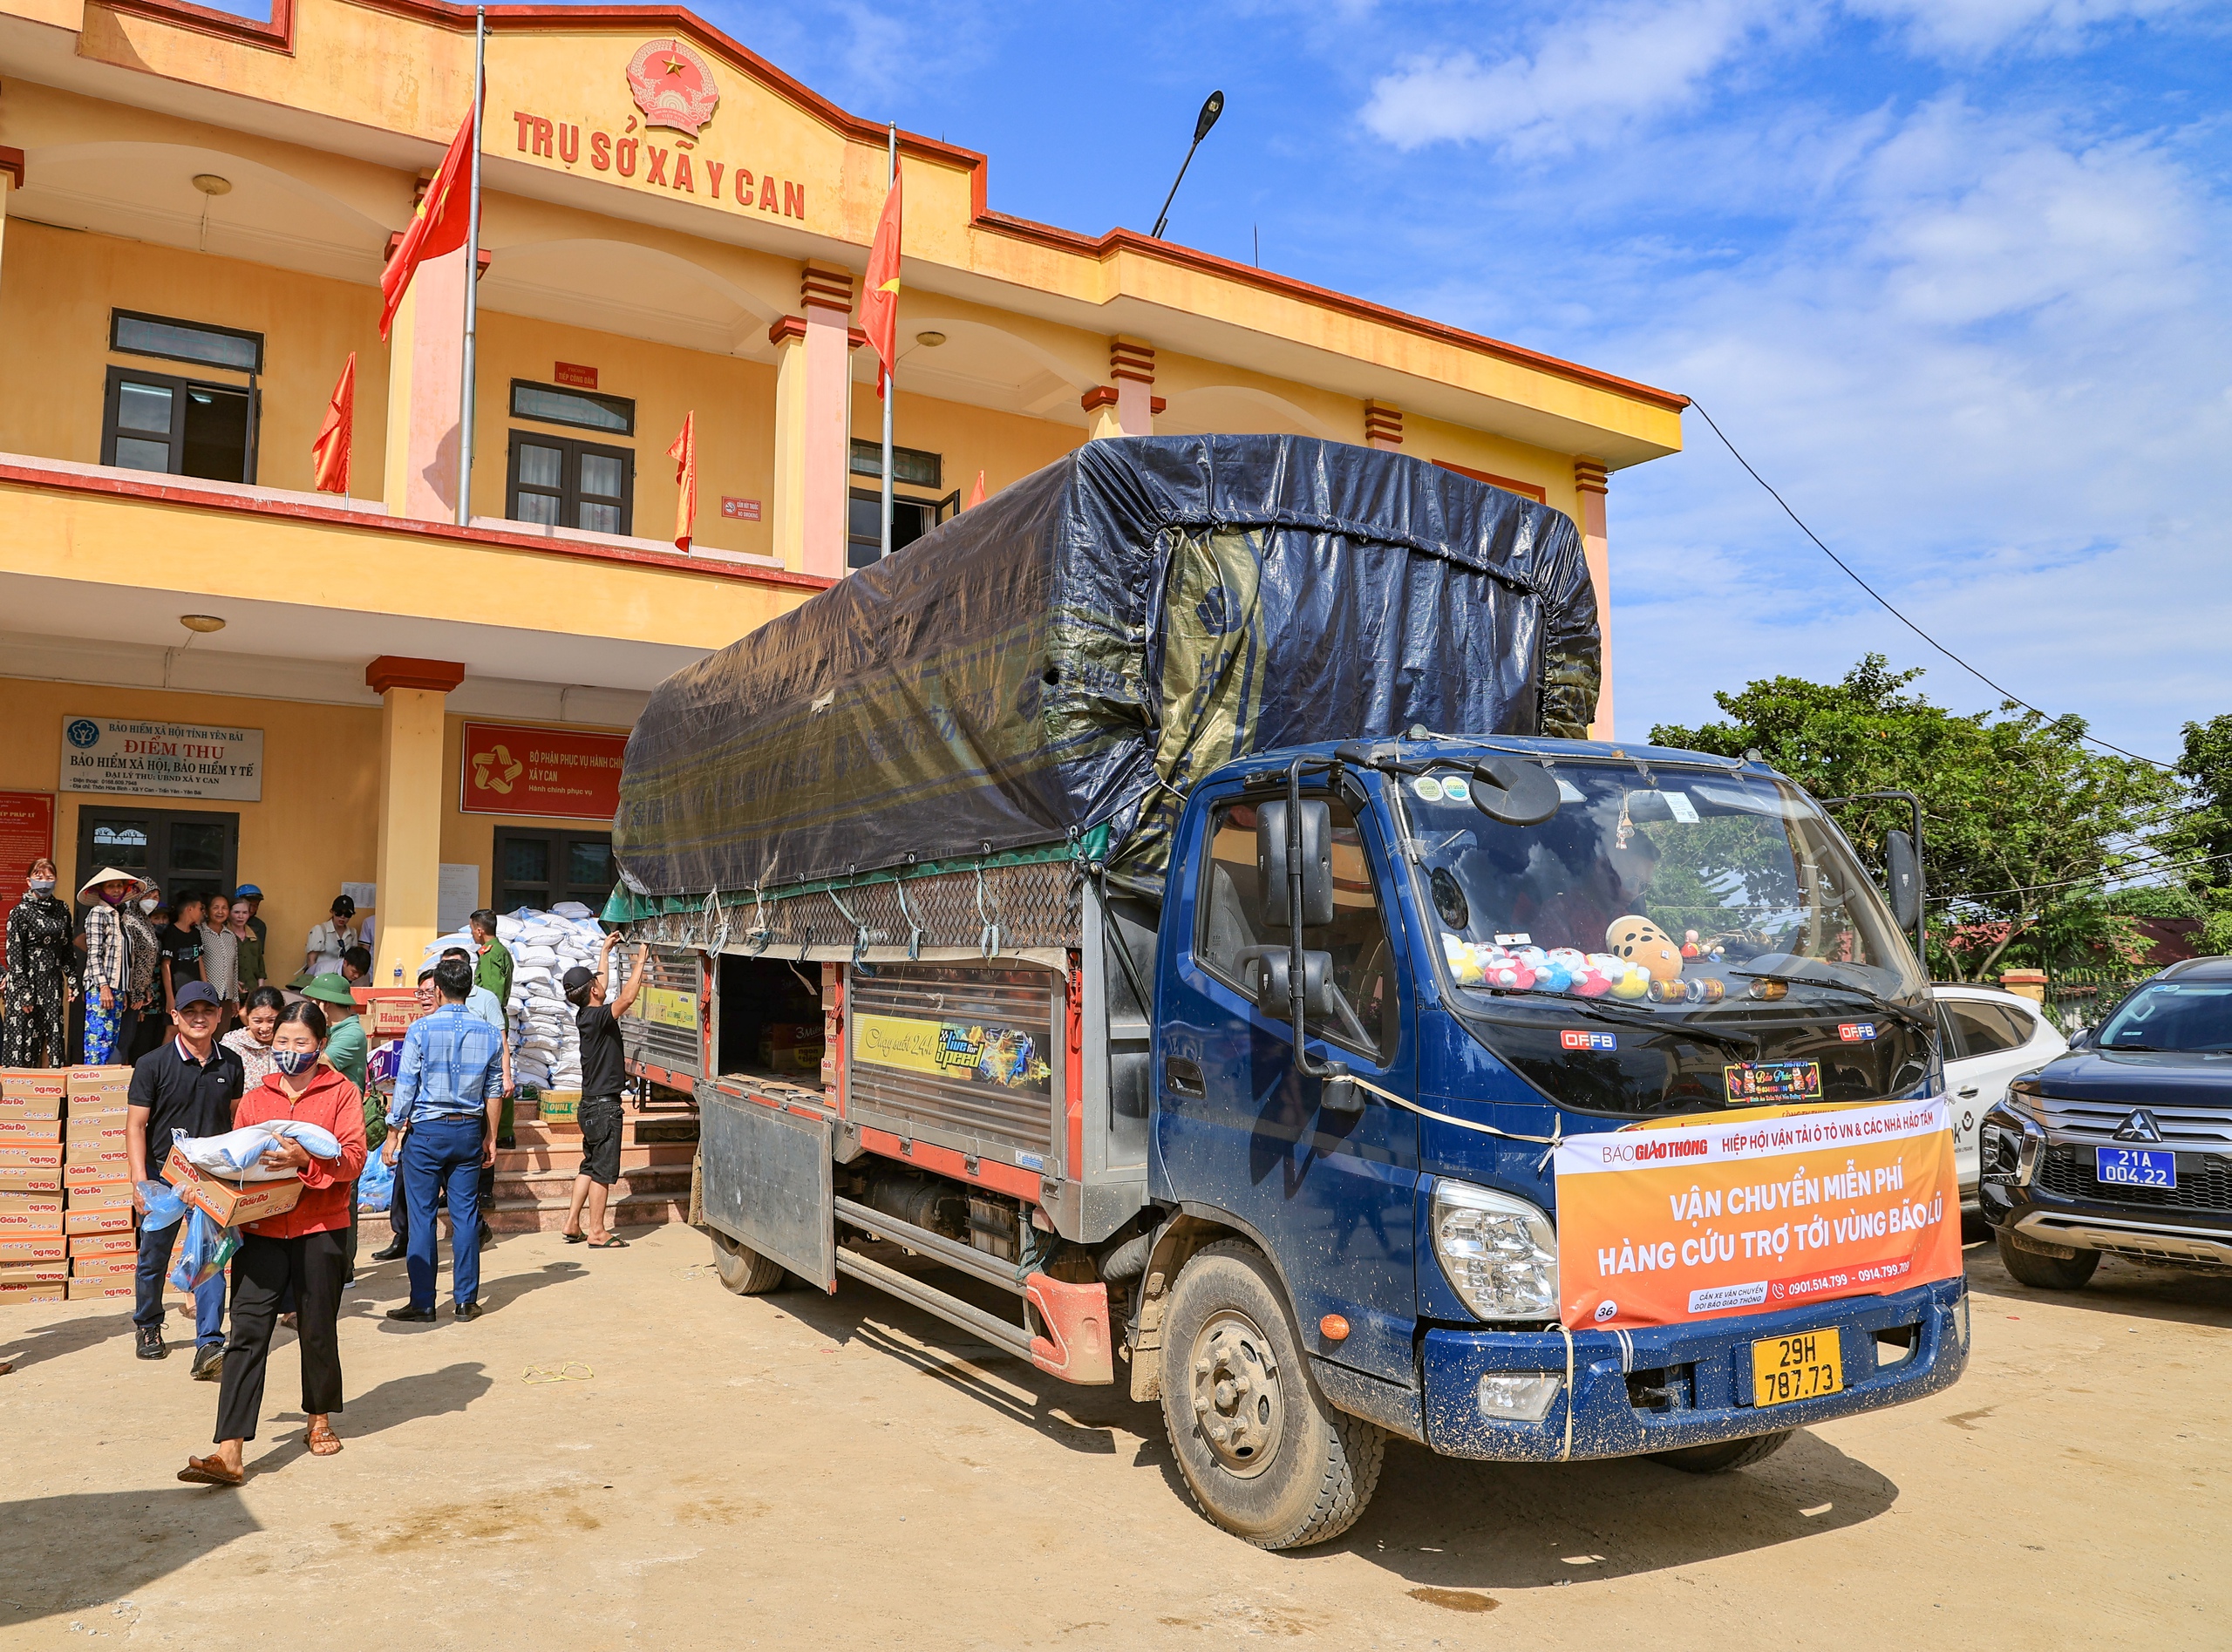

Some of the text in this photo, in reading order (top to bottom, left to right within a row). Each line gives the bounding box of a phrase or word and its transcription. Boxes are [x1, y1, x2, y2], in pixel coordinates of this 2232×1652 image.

[514, 111, 805, 220] TRỤ SỞ XÃ Y CAN
[559, 371, 569, 381] TIẾP
[570, 374, 583, 384] CÔNG
[109, 721, 243, 741] BẢO HIỂM XÃ HỘI TỈNH YÊN BÁI
[124, 736, 225, 759] ĐIỂM THU
[71, 751, 254, 776] BẢO HIỂM XÃ HỘI, BẢO HIỂM Y TẾ
[529, 750, 624, 769] BỘ PHẬN PHỤC VỤ HÀNH CHÍN
[529, 768, 558, 782] XÃ Y CAN
[548, 785, 565, 794] chính
[567, 787, 583, 796] phục
[380, 1013, 405, 1024] Hàng
[796, 1026, 804, 1039] 3
[798, 1048, 819, 1057] ngon
[967, 1044, 978, 1054] for
[1755, 1068, 1793, 1084] Bảo Phúc
[1722, 1110, 1934, 1155] HIỆP HỘI VẬN TẢI Ô TÔ VN & CÁC NHÀ HẢO TÂM
[1668, 1139, 1708, 1158] THÔNG
[2118, 1150, 2152, 1167] 21A
[173, 1155, 200, 1183] Gấu Đỏ
[2105, 1166, 2167, 1186] 004.22
[239, 1192, 269, 1207] Gấu Đỏ
[1669, 1156, 1903, 1228] VẬN CHUYỂN MIỄN PHÍ
[1597, 1190, 1943, 1277] HÀNG CỨU TRỢ TỚI VÙNG BÃO LŨ
[1788, 1261, 1910, 1296] 0901.514.799 0914.799.709
[1724, 1289, 1738, 1300] VẬN
[1739, 1284, 1764, 1296] CHUYỂN
[1598, 1307, 1614, 1317] 36
[1694, 1302, 1706, 1311] GỌI
[1707, 1300, 1721, 1309] BÁO
[1739, 1295, 1762, 1304] THÔNG
[1779, 1335, 1816, 1367] 29H
[1765, 1363, 1834, 1403] 787.73
